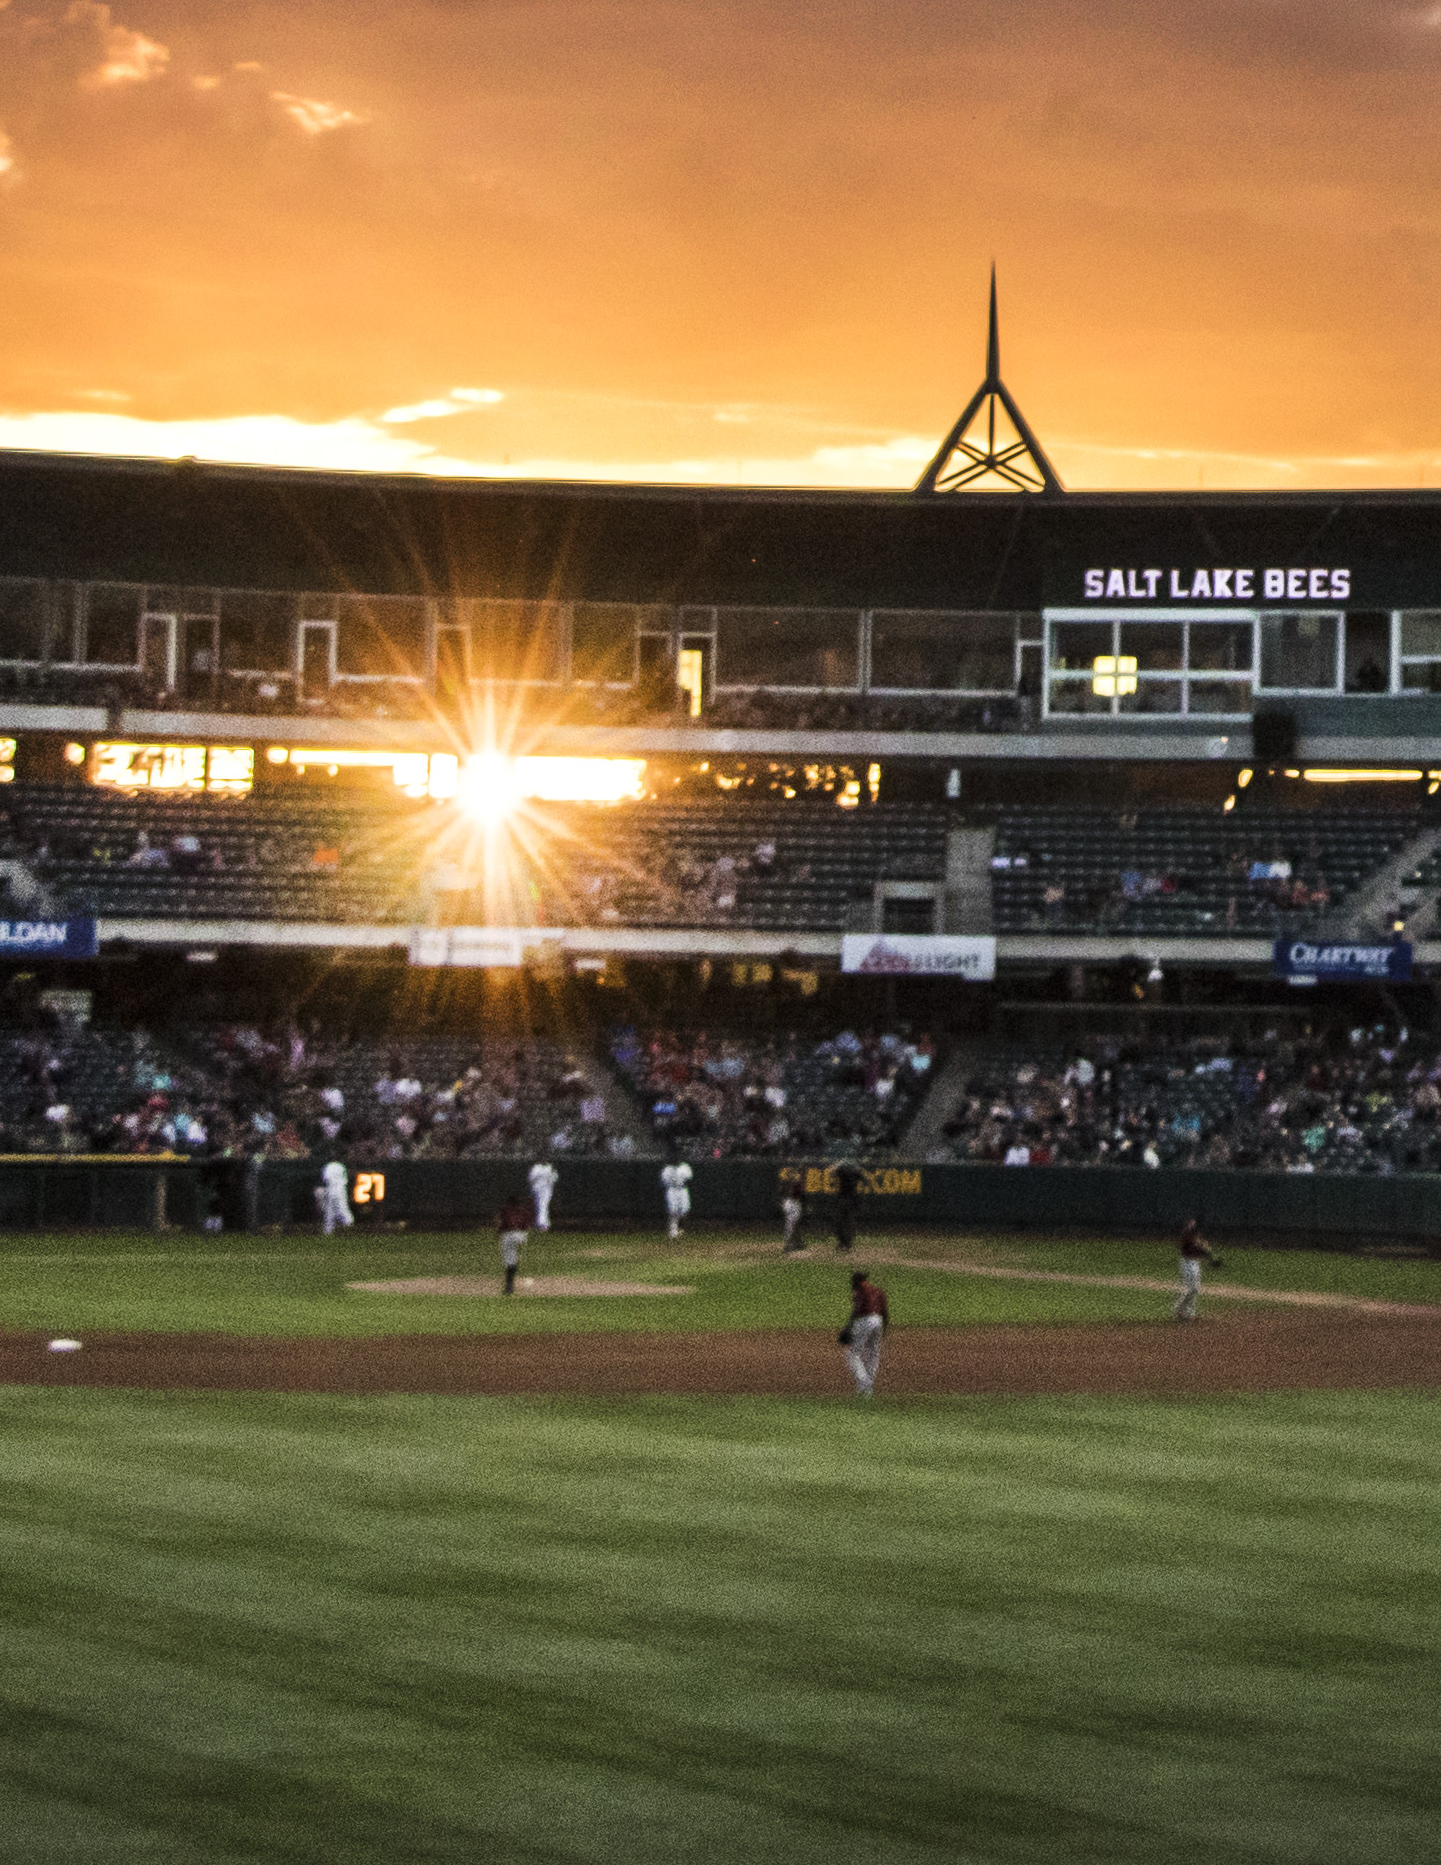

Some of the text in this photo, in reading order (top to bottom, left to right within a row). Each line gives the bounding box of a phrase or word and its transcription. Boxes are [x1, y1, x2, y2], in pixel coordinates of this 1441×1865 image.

[1084, 568, 1351, 598] SALT LAKE BEES
[354, 1172, 386, 1204] 27
